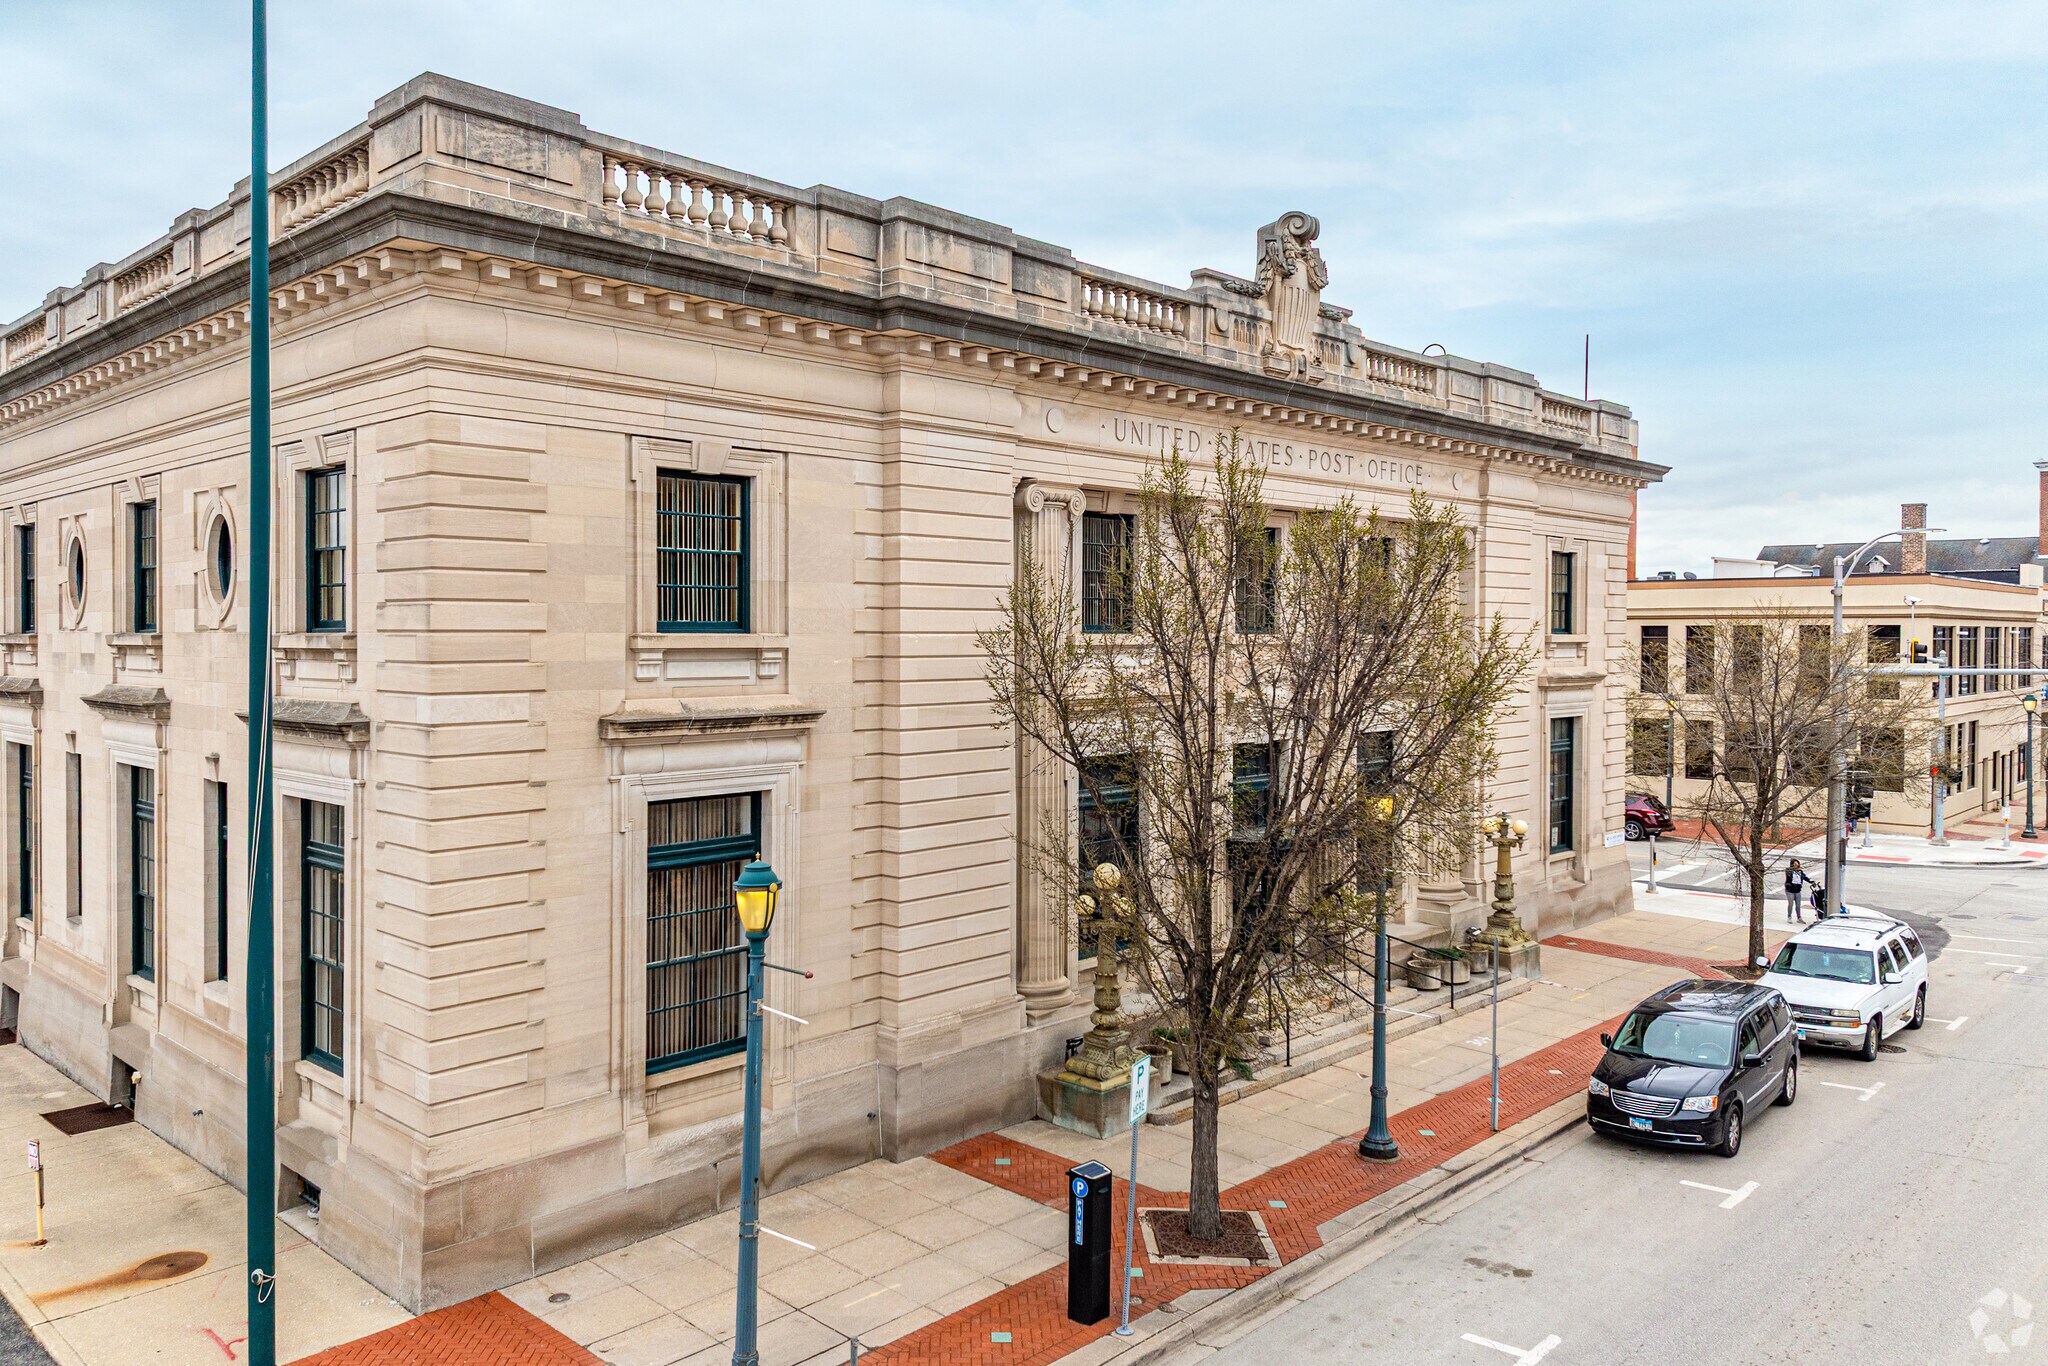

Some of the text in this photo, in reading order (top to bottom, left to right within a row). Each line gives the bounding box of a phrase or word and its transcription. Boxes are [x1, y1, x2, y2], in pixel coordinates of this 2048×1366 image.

[1113, 417, 1201, 453] UNITED
[1308, 449, 1355, 476] POST
[1367, 459, 1424, 486] OFFICE
[1137, 1065, 1144, 1085] P
[1135, 1087, 1144, 1102] PAY
[1133, 1100, 1145, 1116] HERE
[1076, 1181, 1085, 1195] P
